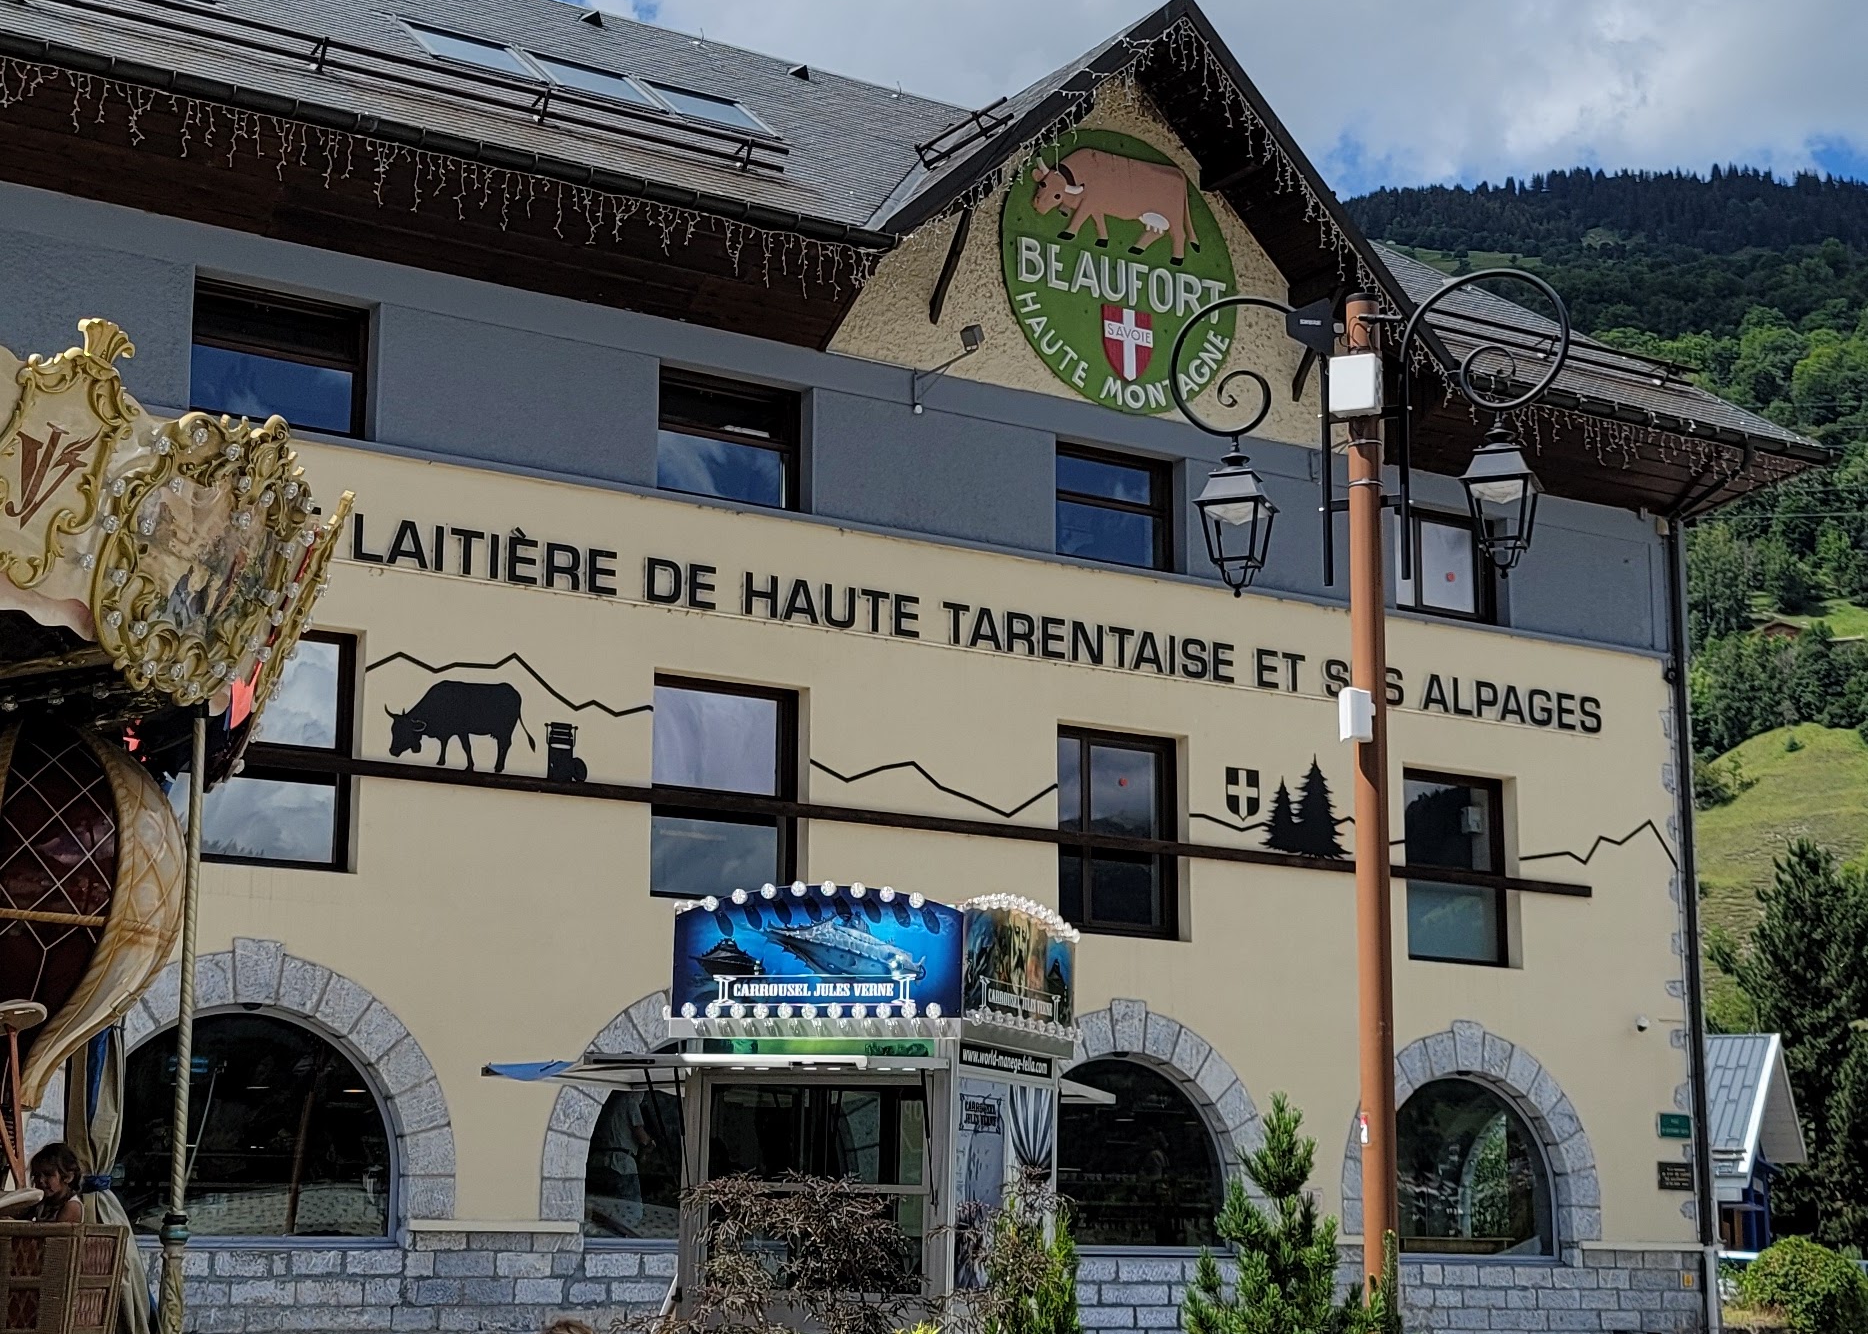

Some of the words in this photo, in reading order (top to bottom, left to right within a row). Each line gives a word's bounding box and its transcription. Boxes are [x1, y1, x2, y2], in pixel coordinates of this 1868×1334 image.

[1016, 236, 1227, 325] BEAUFORT
[1015, 291, 1090, 389] HAUTE
[1107, 323, 1152, 344] SAVOIE
[353, 513, 618, 596] LAITIÈRE
[646, 557, 717, 610] DE
[744, 572, 920, 638] HAUTE
[942, 601, 1234, 683] TARENTAISE
[1256, 648, 1306, 691] ET
[1324, 659, 1404, 706] SS
[1422, 674, 1603, 733] ALPAGES
[733, 983, 811, 997] CARROUSEL
[813, 983, 851, 997] JULES
[853, 983, 894, 997] VERNE
[962, 1048, 1048, 1074] www.world-manege-fella.com
